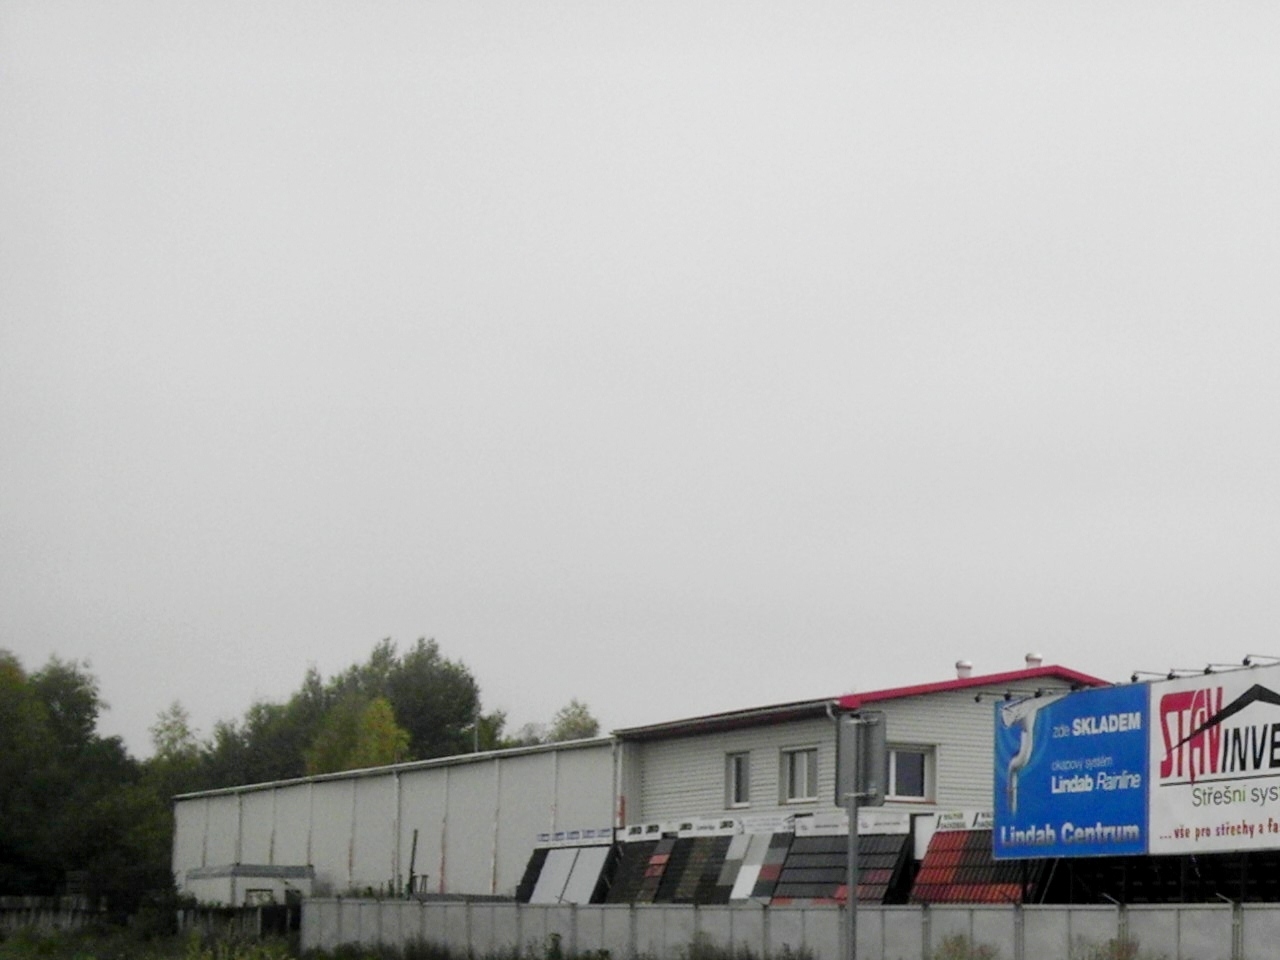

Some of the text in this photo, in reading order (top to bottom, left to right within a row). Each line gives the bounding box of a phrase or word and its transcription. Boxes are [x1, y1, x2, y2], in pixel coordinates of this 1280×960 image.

[1072, 711, 1142, 737] SKLADEM
[1051, 773, 1093, 794] Lindab
[1192, 785, 1247, 807] Střešní
[1001, 824, 1056, 845] Lindab
[1061, 822, 1140, 844] Centrum
[1195, 826, 1212, 842] pro
[1216, 819, 1256, 840] střechy
[1258, 824, 1264, 834] a
